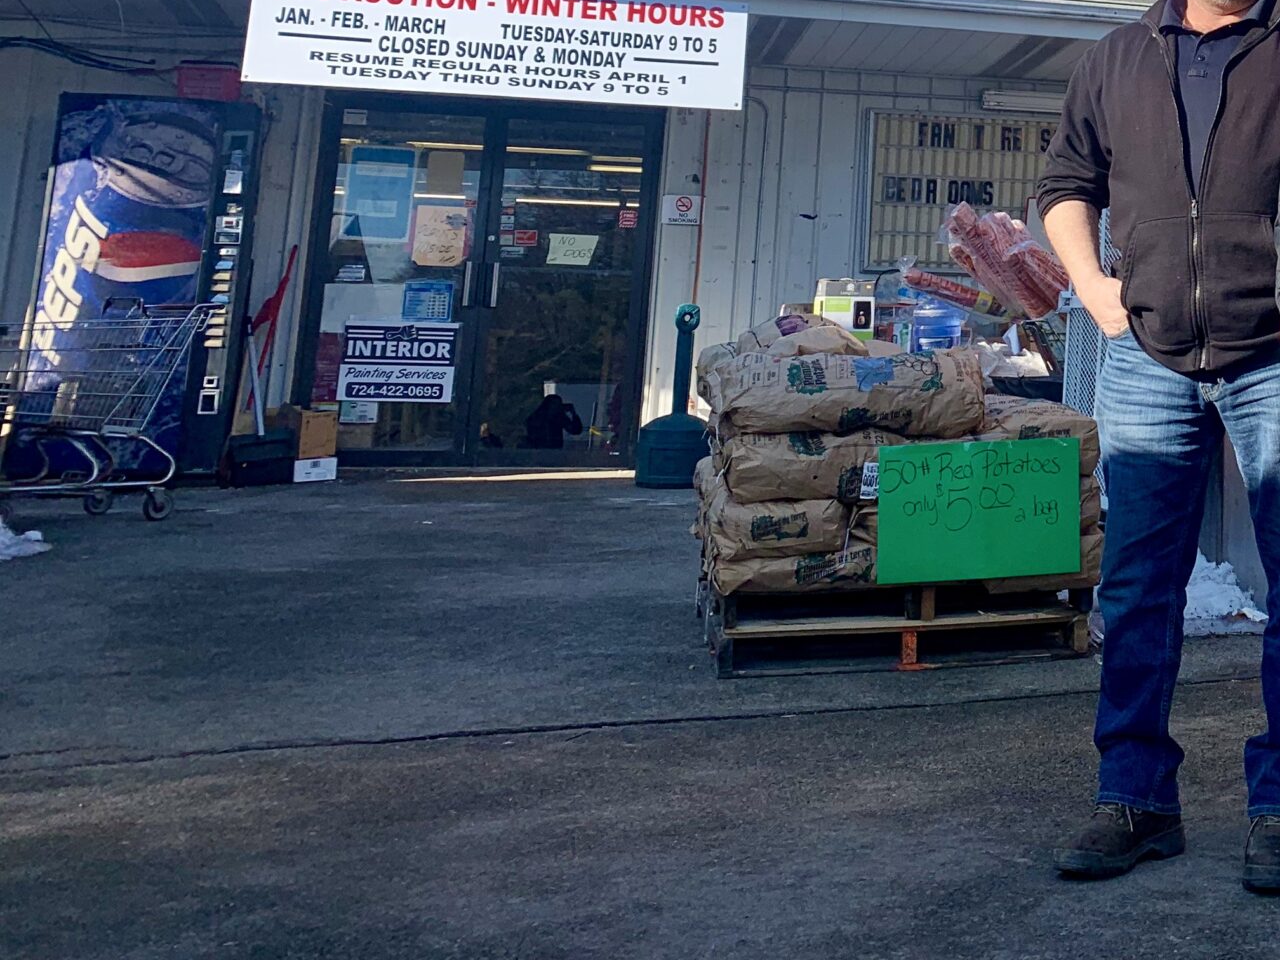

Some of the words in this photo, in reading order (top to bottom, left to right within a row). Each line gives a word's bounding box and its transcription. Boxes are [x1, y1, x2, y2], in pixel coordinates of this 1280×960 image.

[275, 6, 315, 26] JAN.
[331, 11, 369, 30] FEB.
[384, 15, 446, 35] MARCH
[627, 1, 725, 28] HOURS
[378, 35, 450, 56] CLOSED
[455, 41, 528, 62] SUNDAY
[533, 46, 546, 63] &
[552, 48, 626, 68] MONDAY
[501, 24, 664, 51] TUESDAY-SATURDAY
[668, 36, 678, 51] 9
[683, 37, 703, 52] TO
[708, 39, 717, 54] 5
[309, 51, 404, 67] RESUME
[412, 58, 517, 74] REGULAR
[525, 66, 601, 80] HOURS
[608, 71, 670, 84] APRIL
[678, 75, 687, 85] 1
[327, 65, 433, 81] TUESDAY
[438, 72, 500, 86] THRU
[508, 76, 596, 92] SUNDAY
[602, 83, 615, 93] 9
[624, 84, 650, 95] TO
[657, 86, 669, 96] 5
[558, 236, 576, 247] NO
[563, 248, 592, 260] DOGS
[32, 194, 110, 367] PEPSI
[346, 339, 451, 358] INTERIOR
[345, 367, 394, 381] Painting
[396, 369, 447, 380] Services
[351, 384, 440, 397] 724-422-0695
[883, 457, 930, 494] 50#
[934, 452, 974, 481] Red
[971, 449, 1061, 480] Potatoes
[902, 495, 939, 526] only
[1014, 507, 1026, 523] a
[1033, 495, 1059, 525] bag
